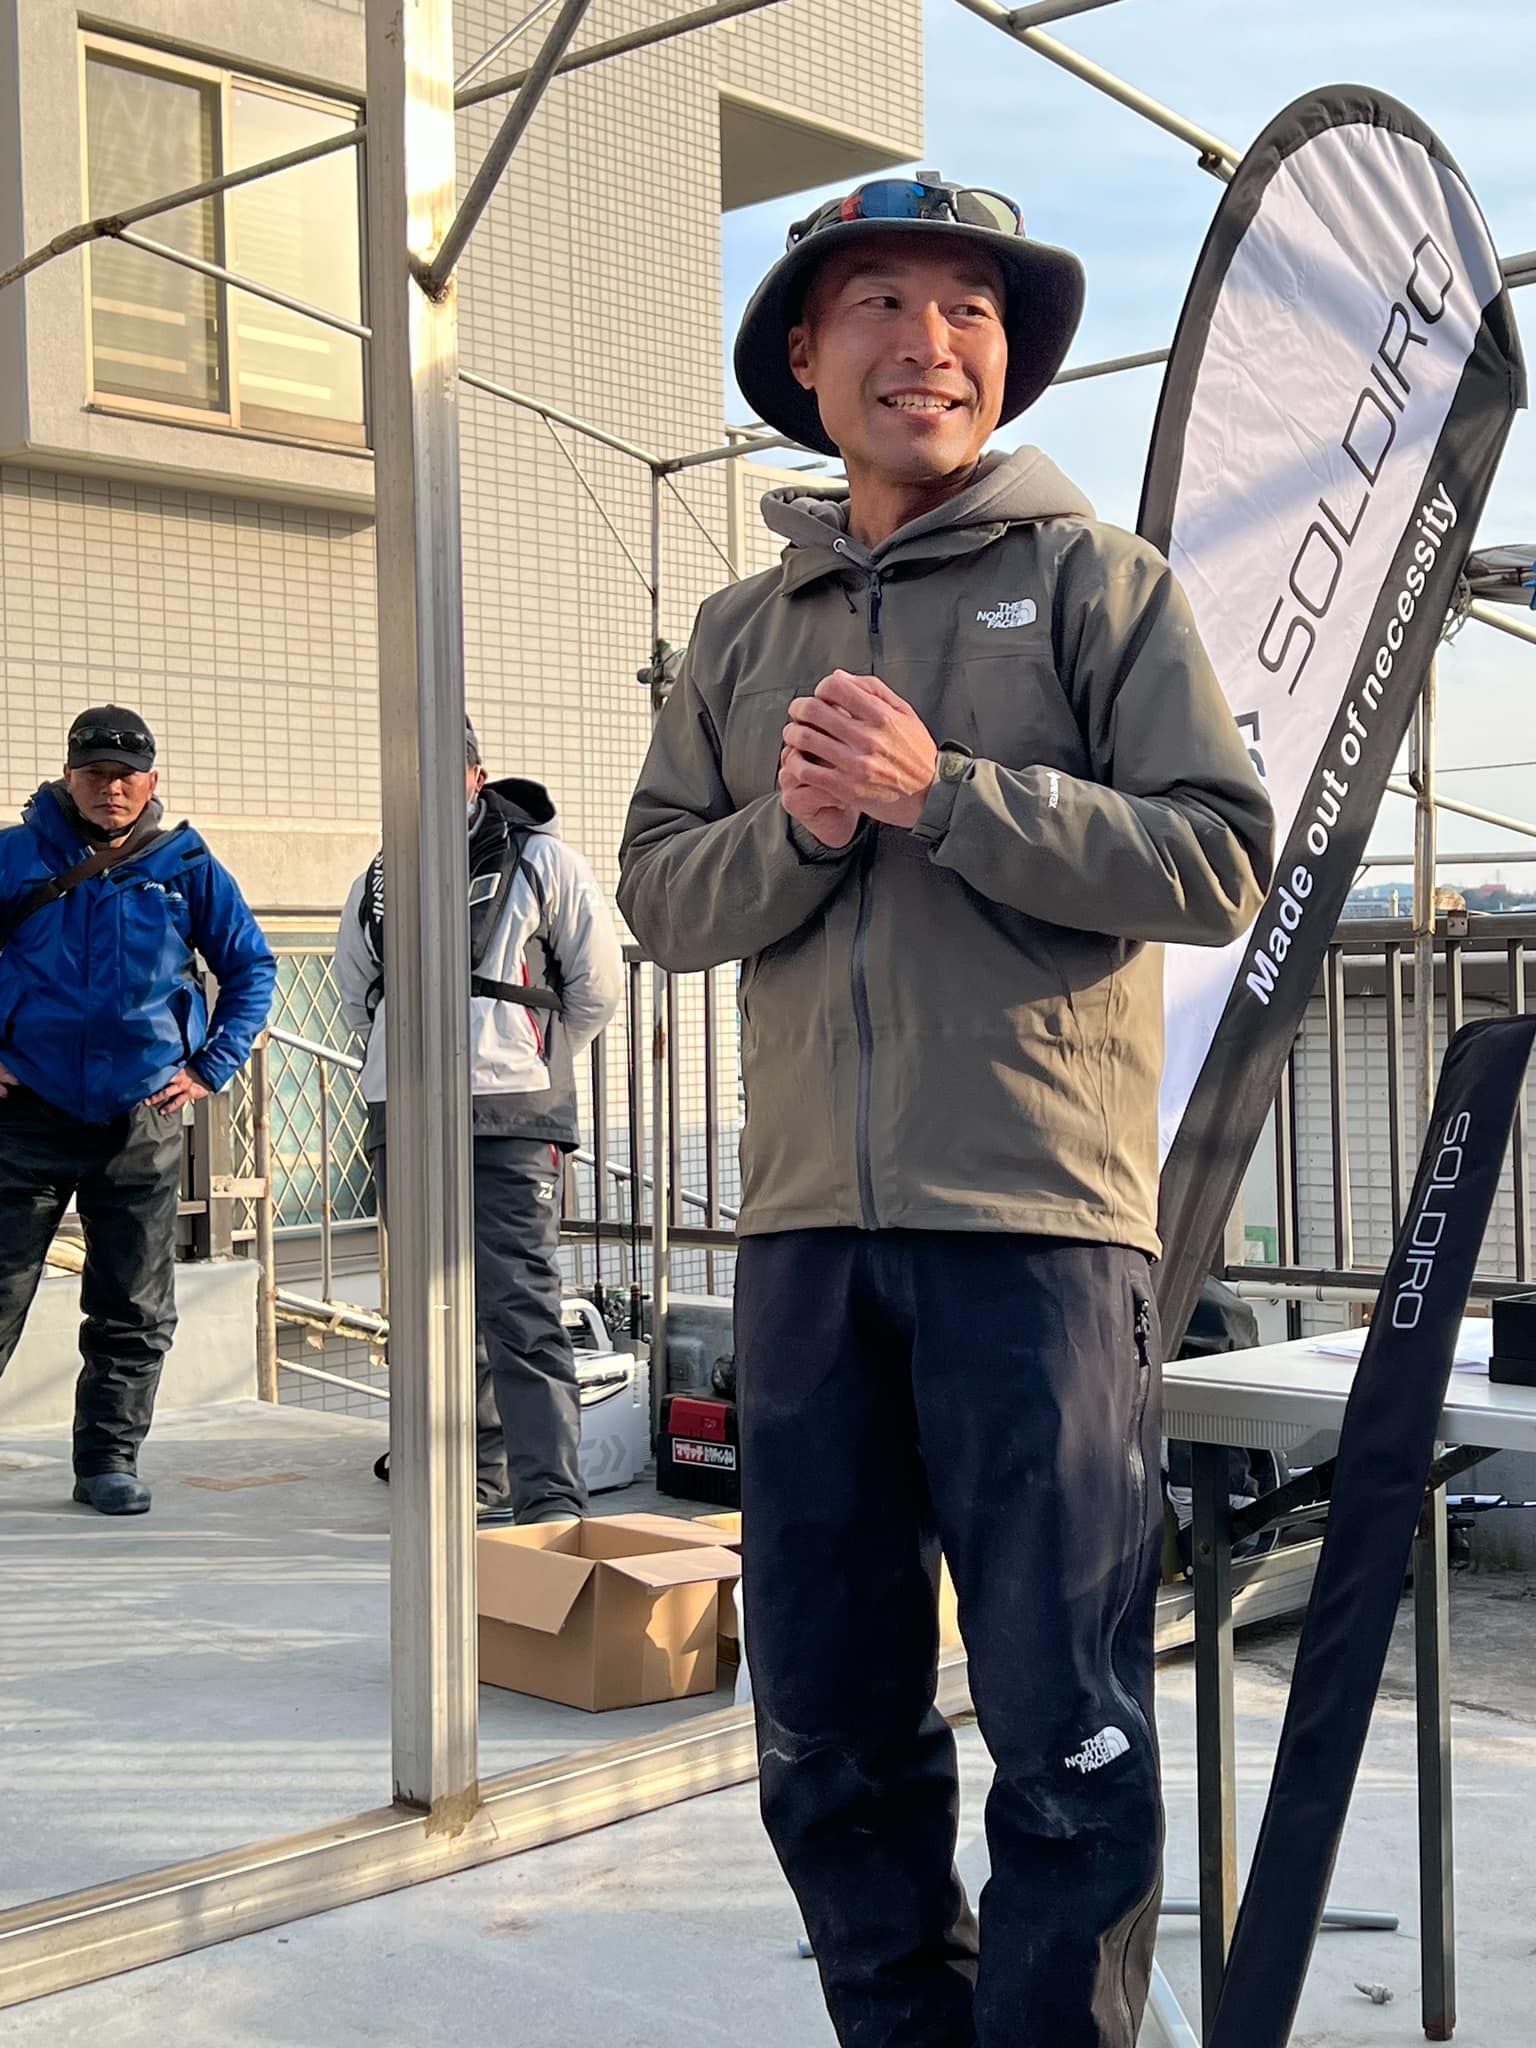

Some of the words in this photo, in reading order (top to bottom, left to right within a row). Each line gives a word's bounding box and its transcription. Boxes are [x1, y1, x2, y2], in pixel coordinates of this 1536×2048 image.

[1258, 232, 1453, 696] SOLDIRO
[976, 610, 1019, 622] NORTH
[997, 602, 1021, 612] THE
[1246, 865, 1313, 1006] Made
[1307, 769, 1349, 856] out
[1340, 702, 1367, 766] of
[1362, 482, 1457, 710] necessity
[1392, 1111, 1471, 1329] SOLDIRO
[1080, 1732, 1105, 1751] THE
[1064, 1742, 1110, 1769] NORTH
[1080, 1753, 1111, 1774] FACE
